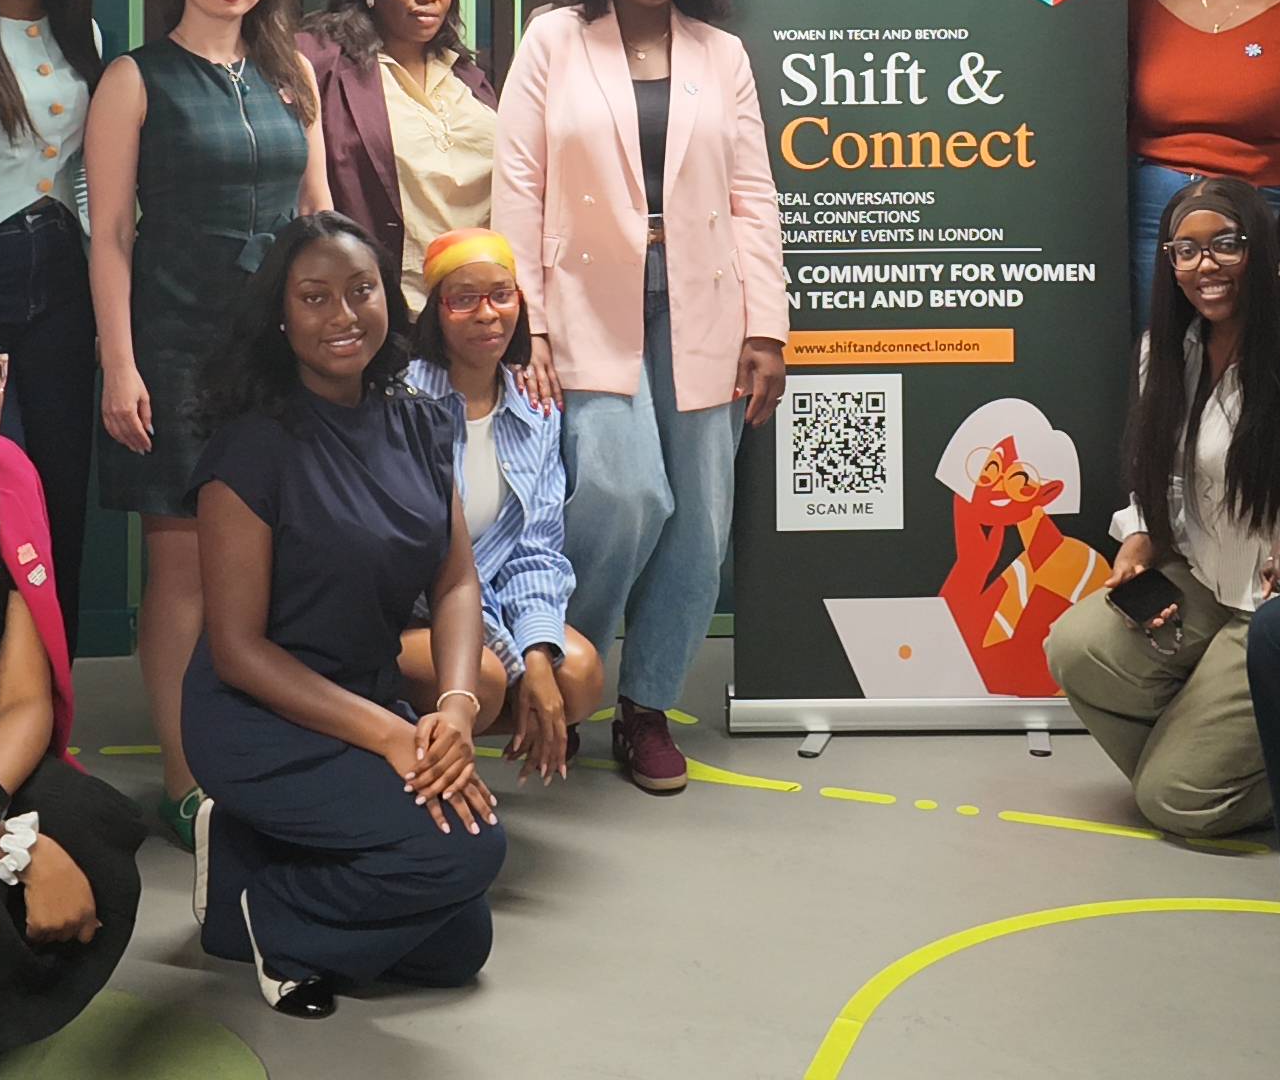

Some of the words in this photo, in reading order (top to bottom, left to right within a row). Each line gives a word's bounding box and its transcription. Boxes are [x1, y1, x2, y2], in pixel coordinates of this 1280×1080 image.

[773, 29, 826, 41] WOMEN
[829, 29, 844, 40] IN
[847, 29, 880, 40] TECH
[882, 29, 912, 40] AND
[915, 28, 969, 40] BEYOND
[779, 51, 928, 107] Shift
[947, 51, 1005, 105] &
[780, 116, 1036, 170] Connect
[775, 192, 811, 206] REAL
[813, 191, 936, 206] CONVERSATIONS
[778, 211, 812, 225] REAL
[813, 210, 921, 225] CONNECTIONS
[780, 229, 857, 244] QUARTERLY
[860, 229, 915, 243] EVENTS
[918, 228, 935, 242] IN
[938, 228, 1004, 242] LONDON
[797, 263, 945, 284] COMMUNITY
[950, 263, 997, 282] FOR
[1000, 263, 1096, 282] WOMEN
[785, 291, 801, 310] N
[806, 290, 865, 310] TECH
[870, 289, 924, 309] AND
[929, 288, 1024, 308] BEYOND
[793, 340, 980, 354] www.shiftandconnect.london
[806, 502, 849, 516] SCAN
[852, 502, 874, 515] ME
